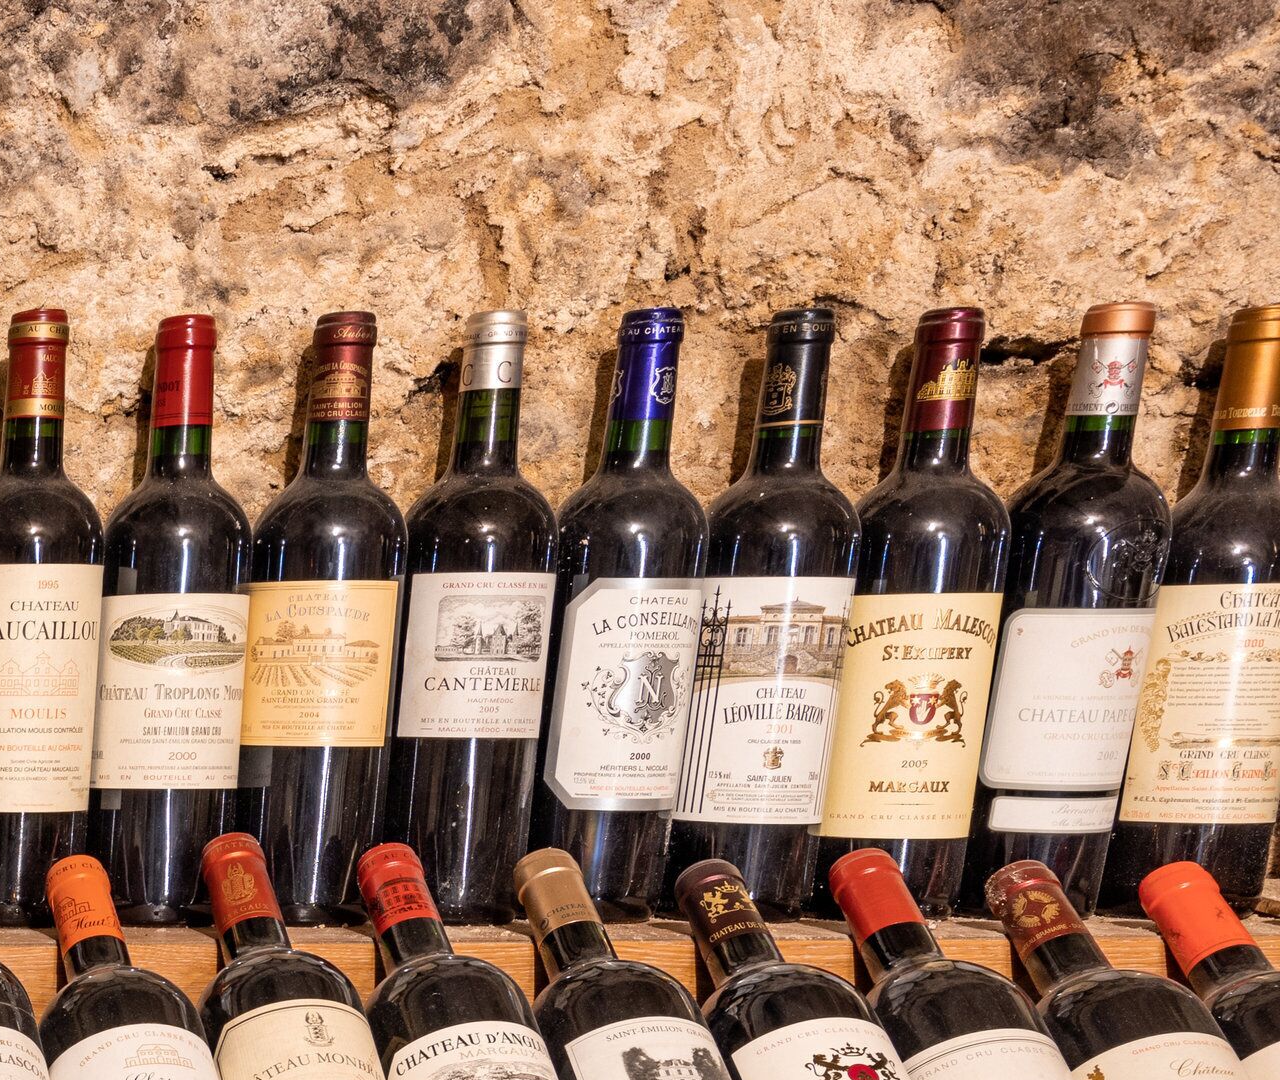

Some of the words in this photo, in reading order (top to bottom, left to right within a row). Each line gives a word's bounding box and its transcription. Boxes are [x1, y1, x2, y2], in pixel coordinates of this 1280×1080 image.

[1072, 403, 1103, 412] CLÉMENT
[38, 580, 59, 589] 1995
[10, 600, 79, 611] CHATEAU
[630, 597, 689, 605] CHATEAU
[592, 620, 610, 635] LA
[847, 613, 923, 647] CHATEAU
[630, 631, 680, 640] POMEROL
[470, 666, 516, 676] CHÂTEAU
[425, 677, 540, 691] CANTEMERLE
[100, 684, 147, 700] CHÂTEAU
[155, 684, 220, 700] TROPLONG
[10, 708, 67, 719] MOULIS
[723, 702, 782, 724] LÉOVILLE
[786, 703, 826, 725] BARTON
[1018, 708, 1098, 723] CHATEAU
[168, 752, 196, 761] 2000
[901, 760, 928, 768] 2005
[869, 781, 949, 793] MARGAUX
[396, 1033, 480, 1076] CHATEAU
[1170, 1058, 1234, 1078] Château
